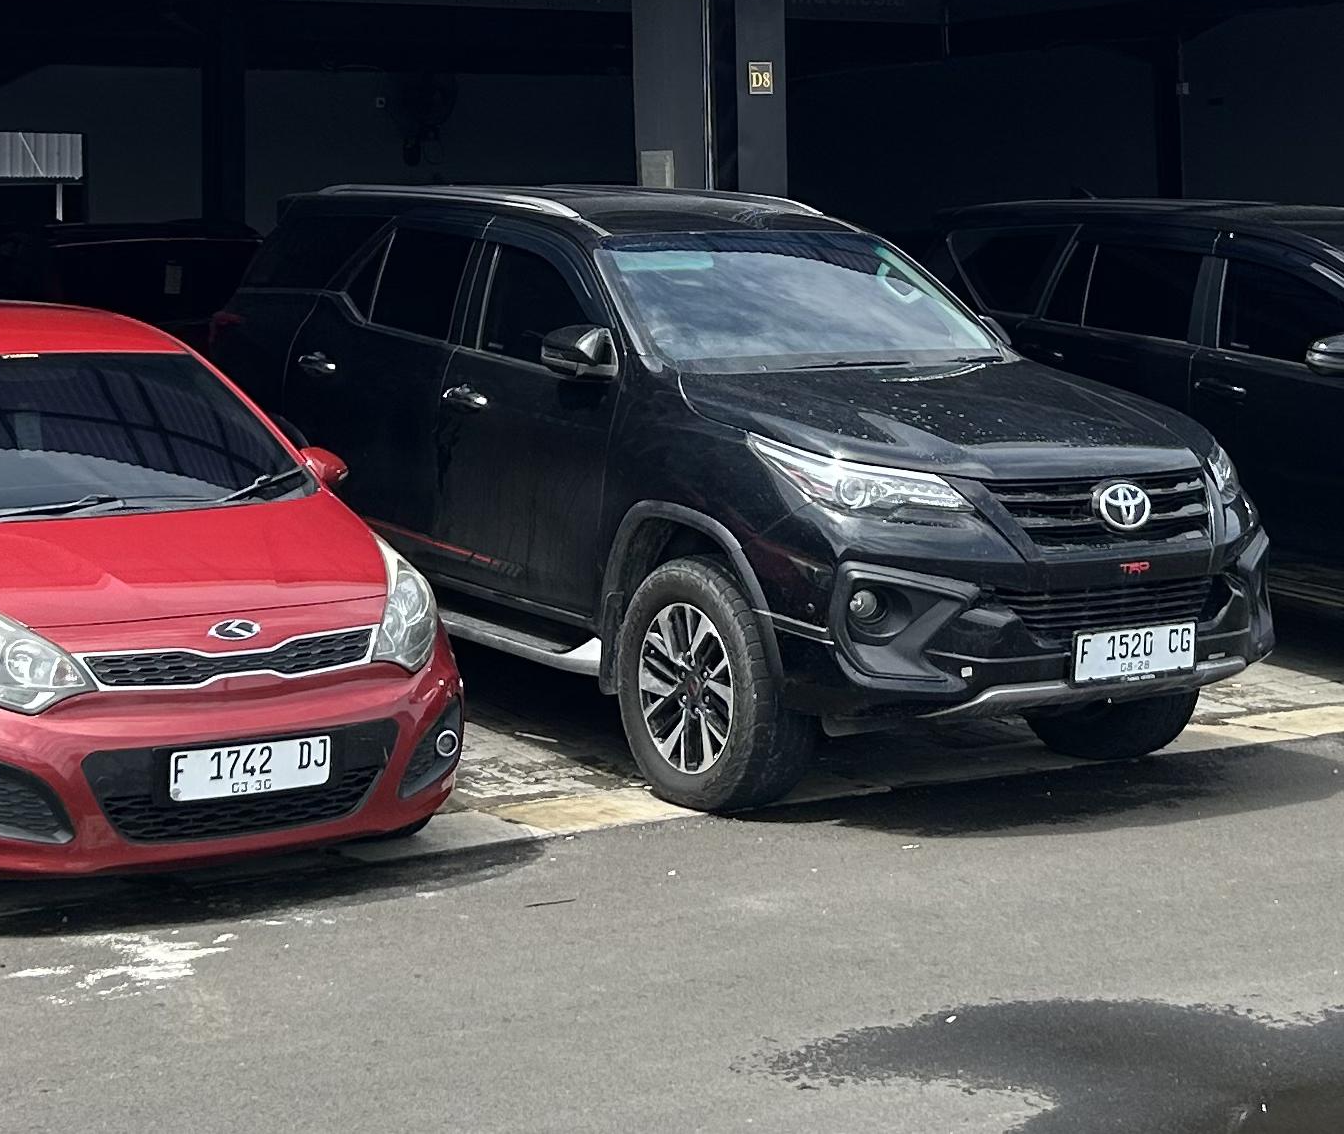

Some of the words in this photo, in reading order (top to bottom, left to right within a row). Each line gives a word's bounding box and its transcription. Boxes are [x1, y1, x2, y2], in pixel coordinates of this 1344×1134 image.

[751, 71, 771, 88] D8
[1080, 638, 1093, 665] F
[1106, 630, 1155, 662] 1520
[1168, 627, 1192, 654] CG
[173, 753, 189, 785] F
[208, 745, 274, 782] 1742
[297, 738, 329, 771] DJ
